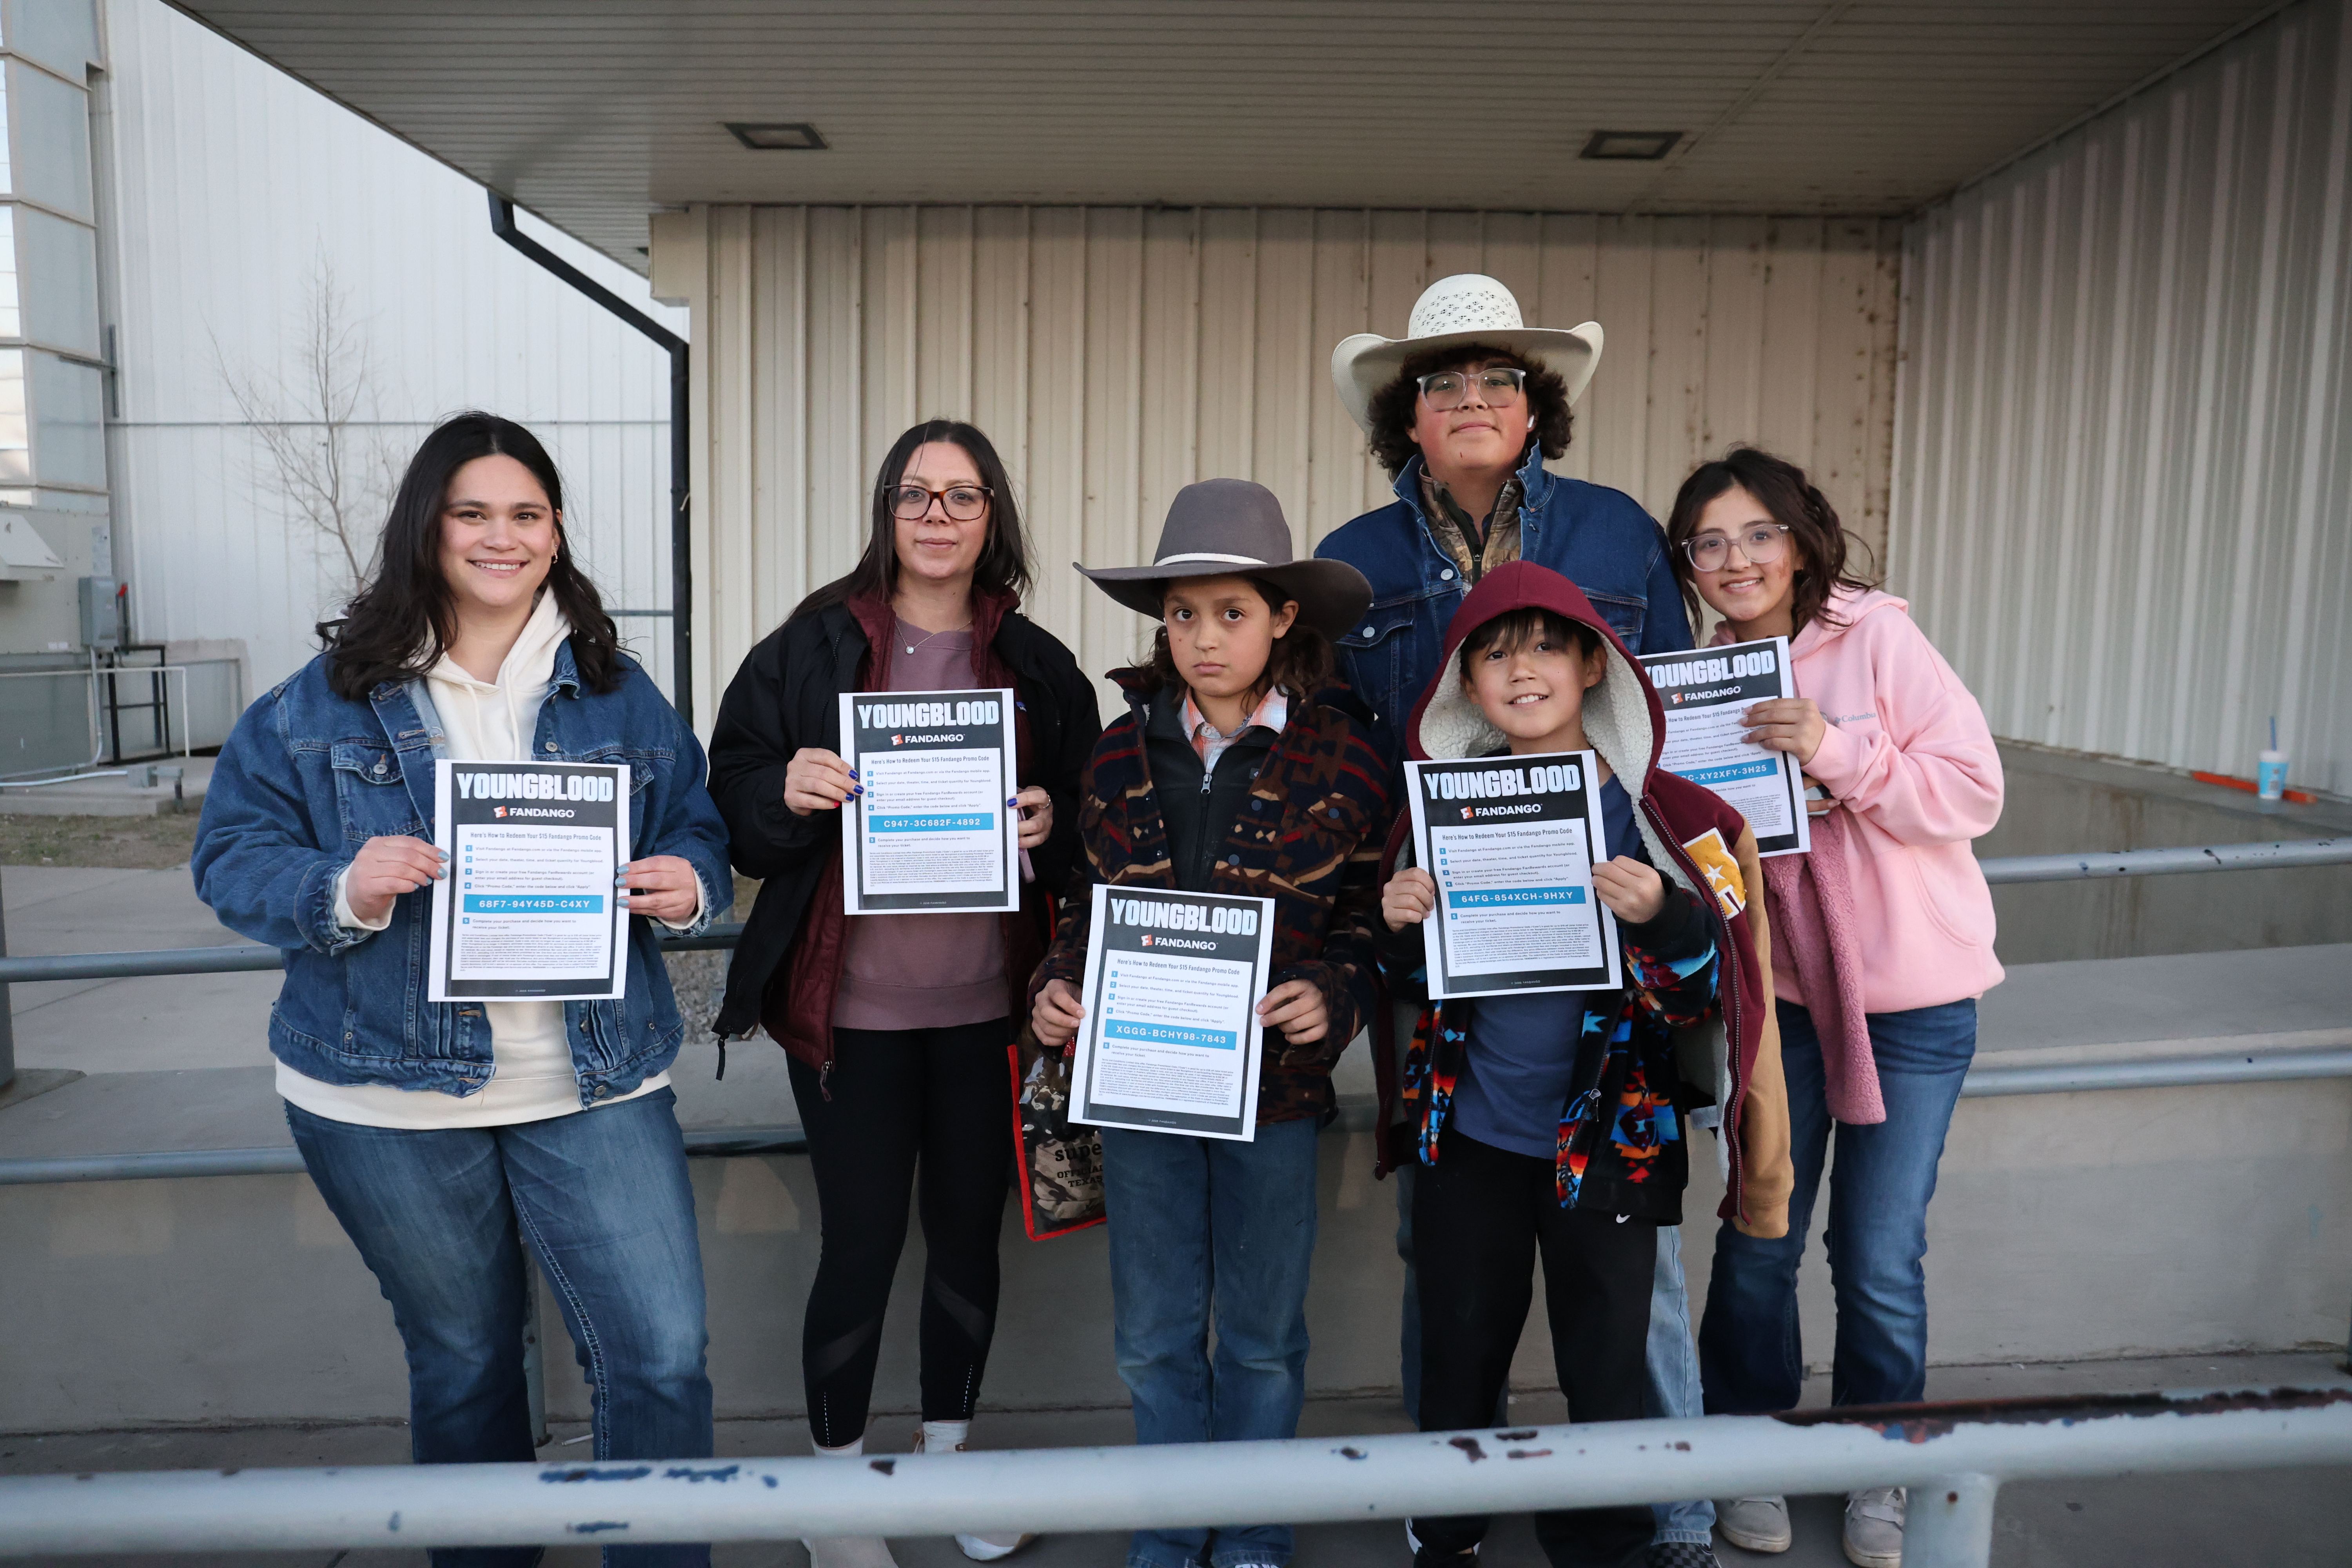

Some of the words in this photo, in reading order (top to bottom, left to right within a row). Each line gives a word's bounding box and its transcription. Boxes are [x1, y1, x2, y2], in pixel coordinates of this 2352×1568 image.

[1685, 686, 1741, 701] FANDANGO
[857, 701, 999, 728] YOUNGBLOOD
[1841, 712, 1876, 722] Columbia
[905, 734, 964, 743] FANDANGO
[456, 773, 613, 802] YOUNGBLOOD
[1424, 764, 1581, 800] YOUNGBLOOD
[510, 808, 575, 818] FANDANGO
[1475, 804, 1541, 817] FANDANGO
[884, 818, 980, 828] C947-3C682F-4892
[1462, 892, 1572, 902] 64FG-854XCH-9HXY
[1111, 898, 1258, 936] YOUNGBLOOD
[1155, 937, 1216, 950] FANDANGO
[1188, 965, 1211, 973] Fandango
[1116, 1025, 1226, 1044] XGGG-BCHY98-7843
[1068, 1175, 1102, 1187] TEXAS
